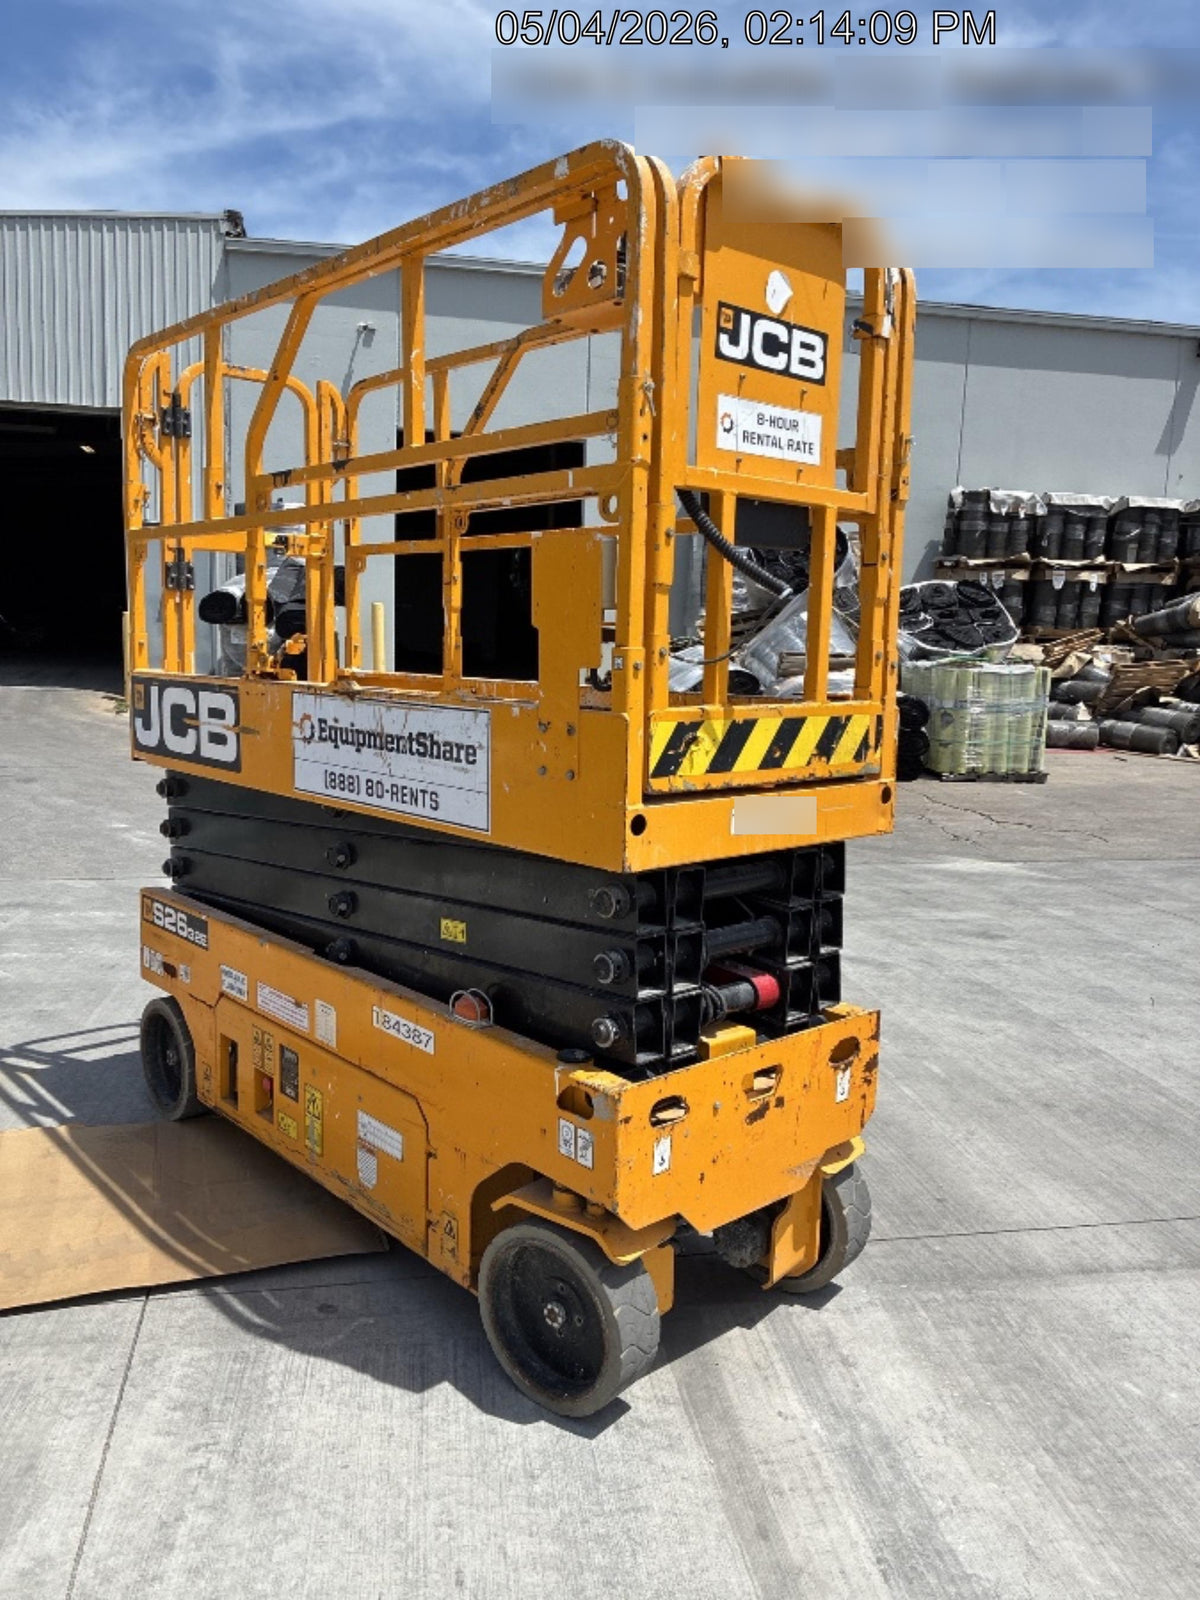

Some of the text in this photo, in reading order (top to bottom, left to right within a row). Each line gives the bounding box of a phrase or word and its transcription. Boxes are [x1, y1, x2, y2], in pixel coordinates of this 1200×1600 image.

[718, 312, 824, 380] JCB
[742, 430, 815, 455] RENTAL RATE
[756, 413, 799, 432] 8-HOUR
[134, 685, 238, 763] JCB
[317, 717, 477, 765] EquipmentShare
[324, 769, 440, 811] (888) 80-RENTS
[374, 1009, 432, 1048] 184387
